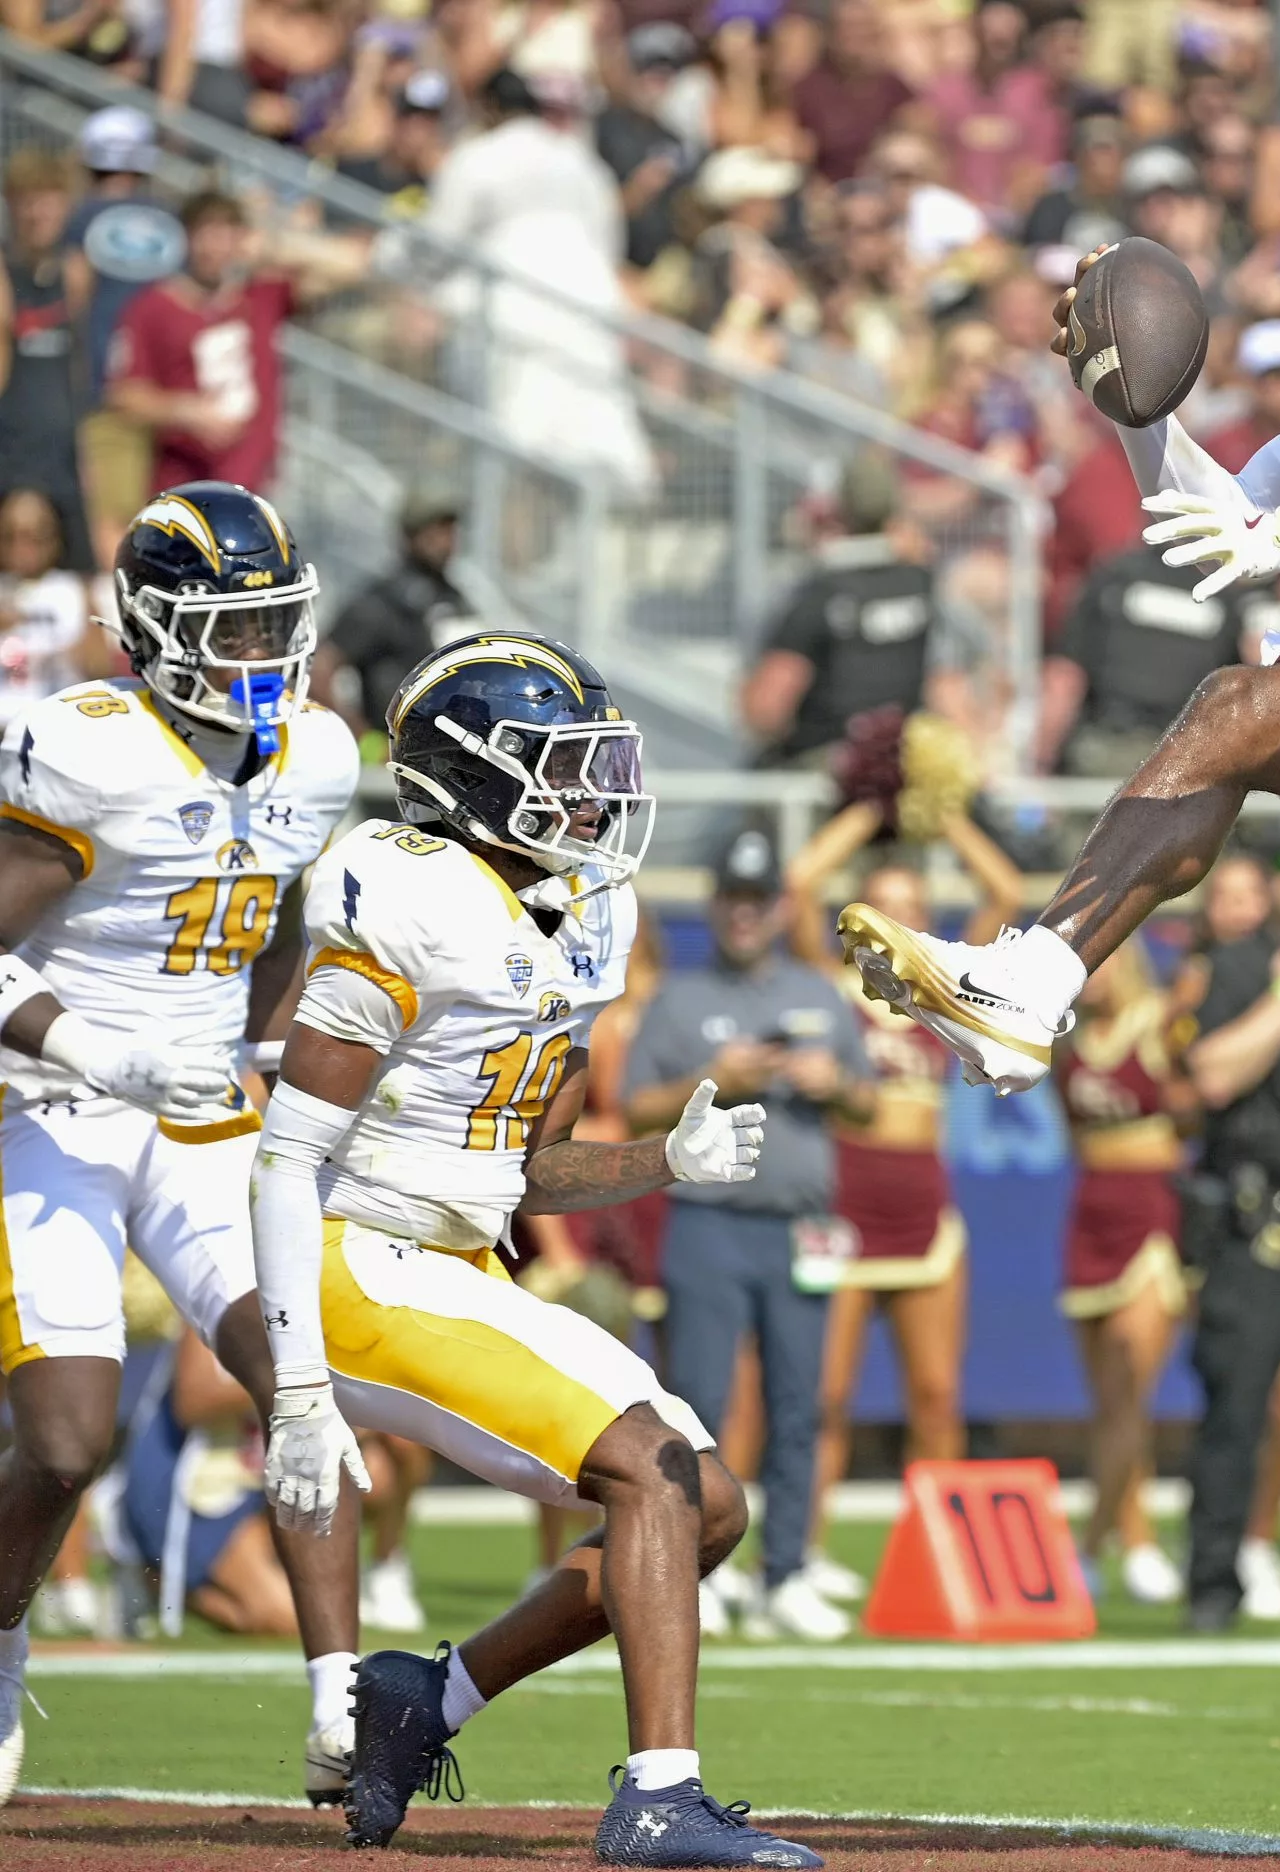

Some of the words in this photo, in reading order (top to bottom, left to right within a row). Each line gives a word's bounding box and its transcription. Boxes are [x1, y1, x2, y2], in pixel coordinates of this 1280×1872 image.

[59, 691, 130, 718] 18
[955, 992, 996, 1007] AIR
[996, 1003, 1025, 1014] ZOOM
[948, 1492, 1057, 1603] 10
